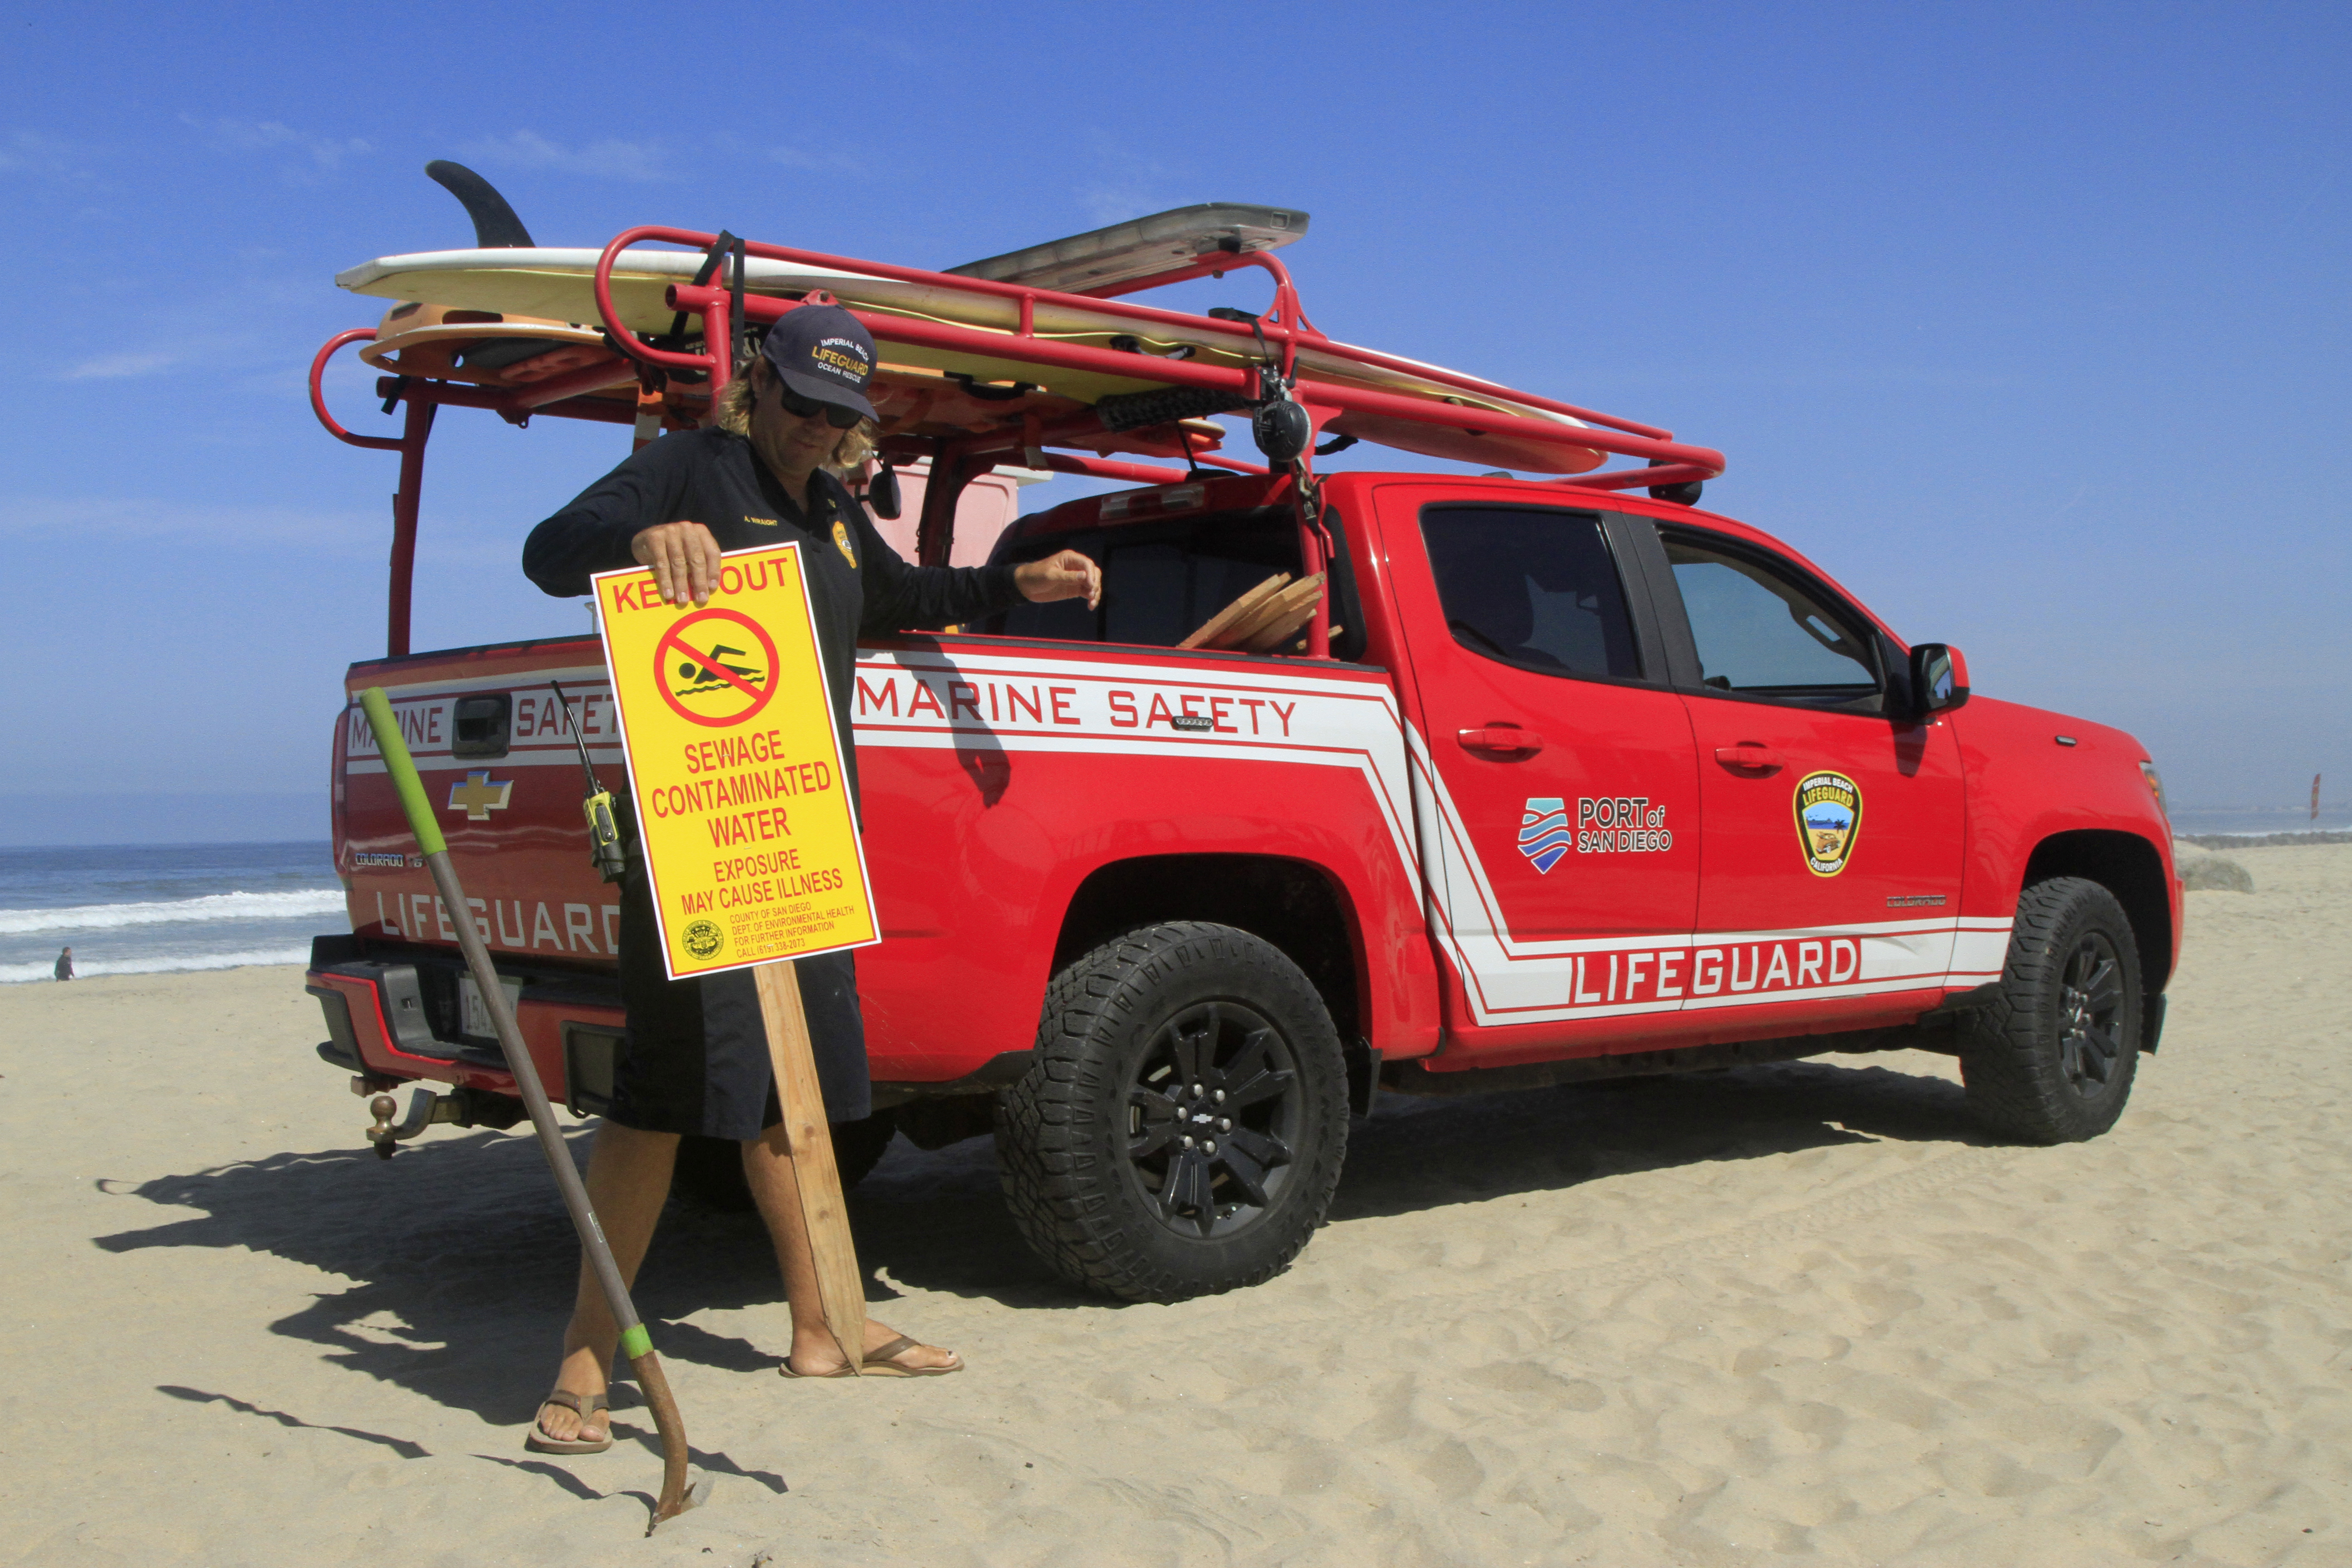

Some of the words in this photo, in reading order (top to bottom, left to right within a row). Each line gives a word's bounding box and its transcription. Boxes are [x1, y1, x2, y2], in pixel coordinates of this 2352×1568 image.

[811, 346, 868, 376] LIFEGUARD
[820, 338, 854, 349] IMPERIAL
[855, 343, 869, 363] BEACH
[818, 362, 841, 375] OCEAN
[842, 370, 862, 383] RESCUE
[612, 569, 701, 613] KE
[719, 557, 787, 595] OUT
[353, 706, 443, 749] MINE
[517, 694, 618, 737] SAFET
[856, 676, 1081, 726] MARINE
[1107, 689, 1296, 739] SAFETY
[685, 730, 785, 774] SEWAGE
[652, 761, 831, 818] CONTAMINATED
[1802, 786, 1854, 807] LIFEGUARD
[1803, 777, 1832, 791] IMPERIAL
[1832, 777, 1854, 793] BEACH
[708, 807, 791, 848] WATER
[1578, 797, 1648, 828] PORT
[1646, 804, 1665, 828] of
[1577, 831, 1615, 853] SAN
[1618, 830, 1672, 852] DIEGO
[356, 853, 404, 867] COLORADO
[713, 848, 801, 882] EXPOSURE
[1810, 857, 1843, 872] CALIFORNIA
[681, 890, 714, 915] MAY
[719, 880, 774, 908] CAUSE
[776, 867, 843, 899] ILLNESS
[1886, 894, 1946, 908] COLORADO
[730, 911, 759, 924] COUNTY
[761, 909, 770, 919] OF
[772, 906, 788, 916] SAN
[788, 902, 812, 914] DIEGO
[732, 924, 752, 936] DEPT.
[754, 921, 764, 932] OF
[765, 912, 825, 930] ENVIRONMENTAL
[826, 905, 855, 919] HEALTH
[734, 936, 749, 947] FOR
[751, 931, 784, 944] FURTHER
[785, 921, 835, 938] INFORMATION
[736, 948, 756, 958] CALL
[757, 944, 774, 955] (619)
[774, 938, 806, 951] 338-2073
[1575, 938, 1858, 1004] LIFEGUARD
